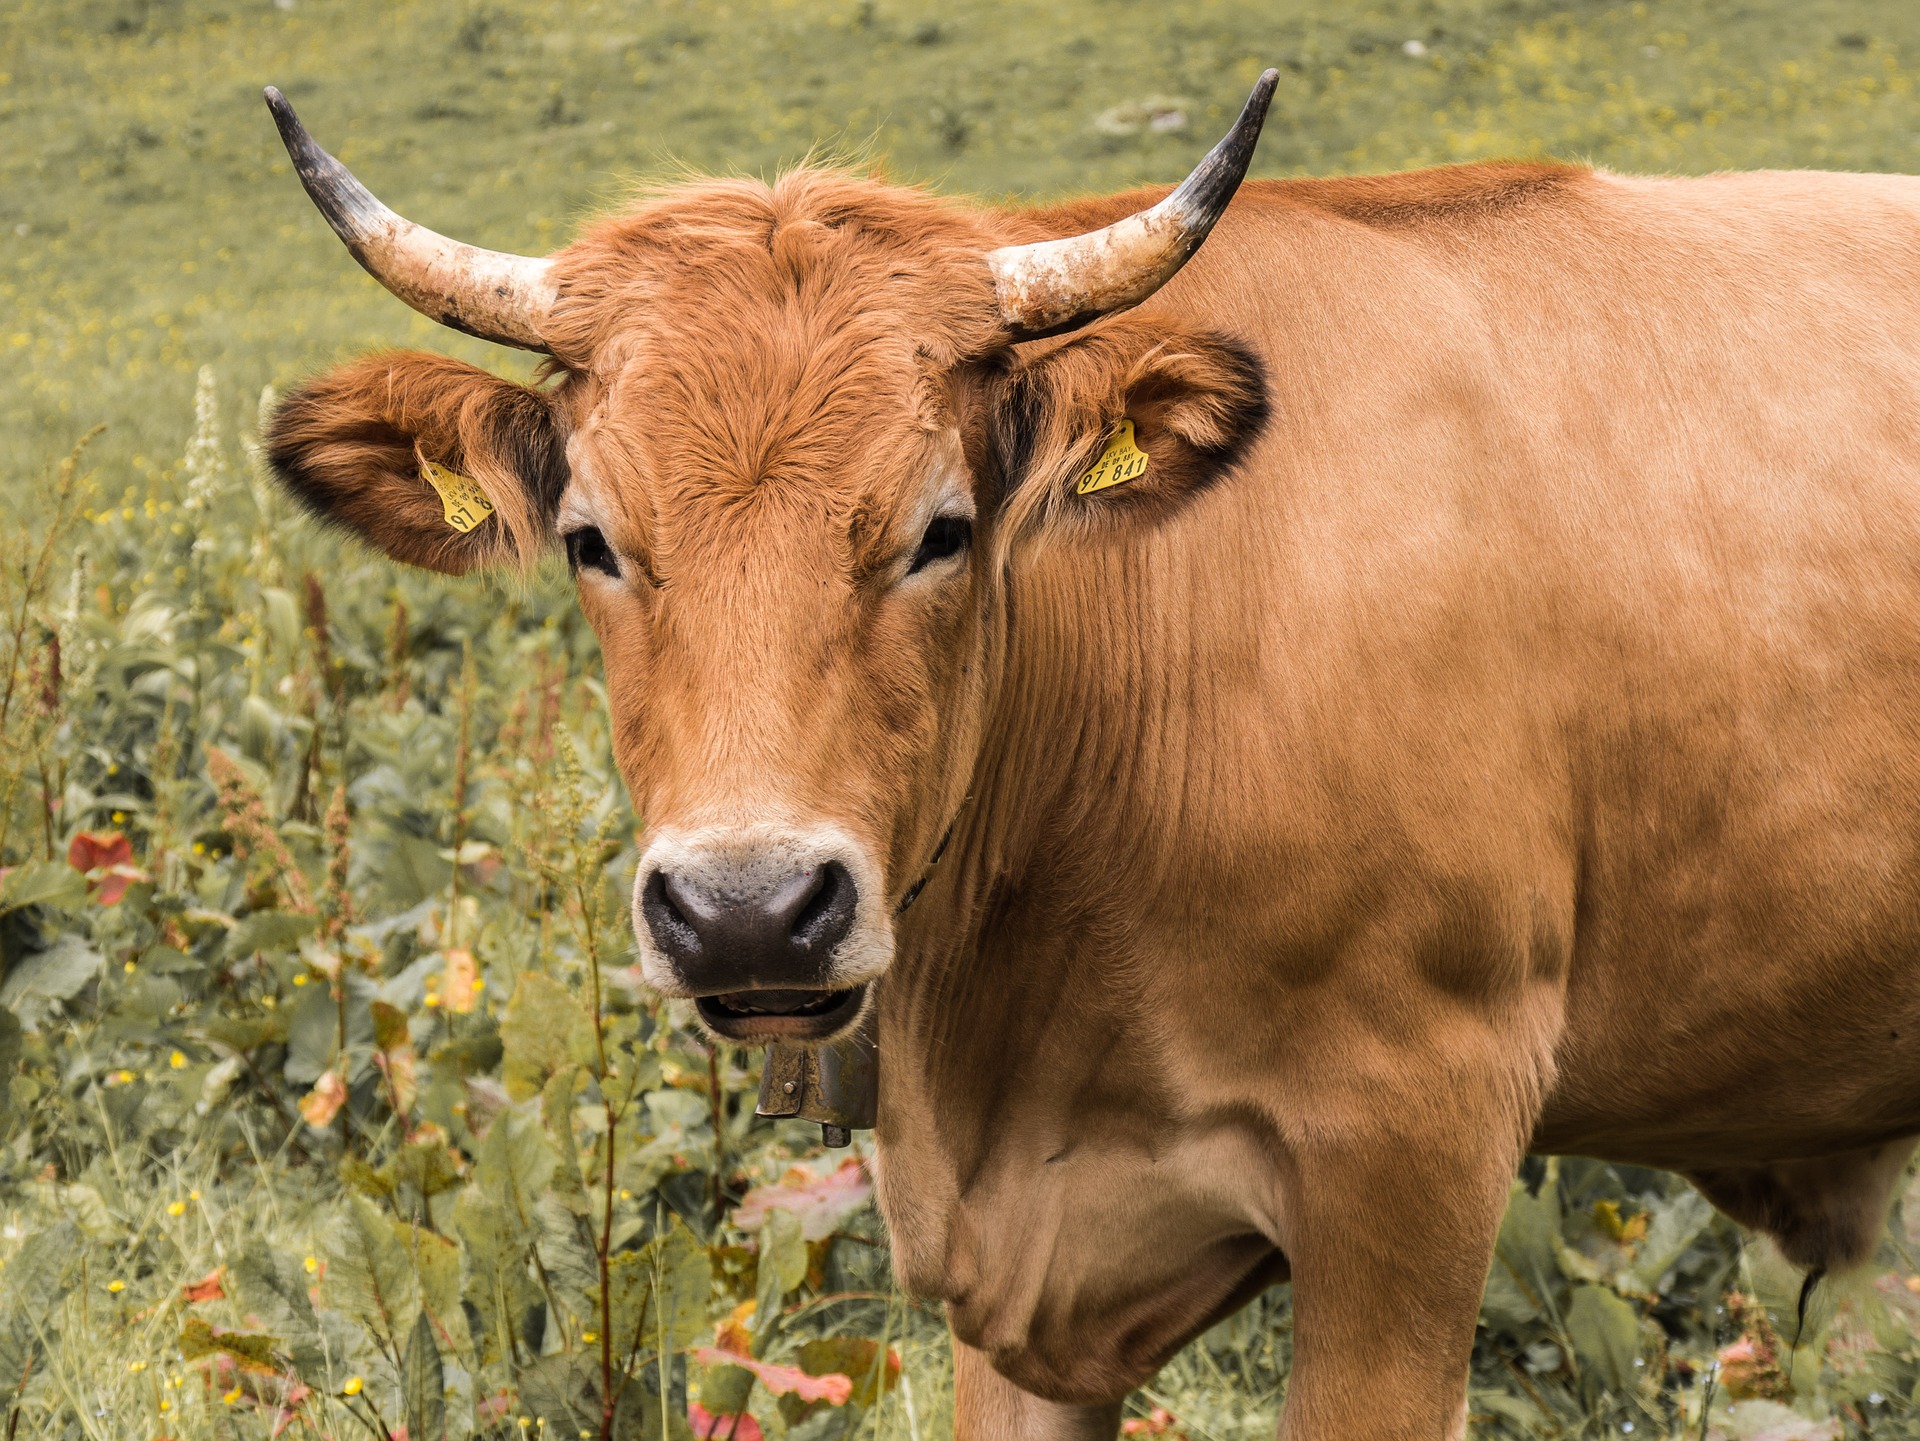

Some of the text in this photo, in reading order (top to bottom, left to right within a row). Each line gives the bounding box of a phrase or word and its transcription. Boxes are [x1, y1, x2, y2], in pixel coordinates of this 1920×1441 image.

[1106, 445, 1132, 459] LKV BAY
[1081, 456, 1144, 492] 97 841
[450, 507, 476, 529] 97
